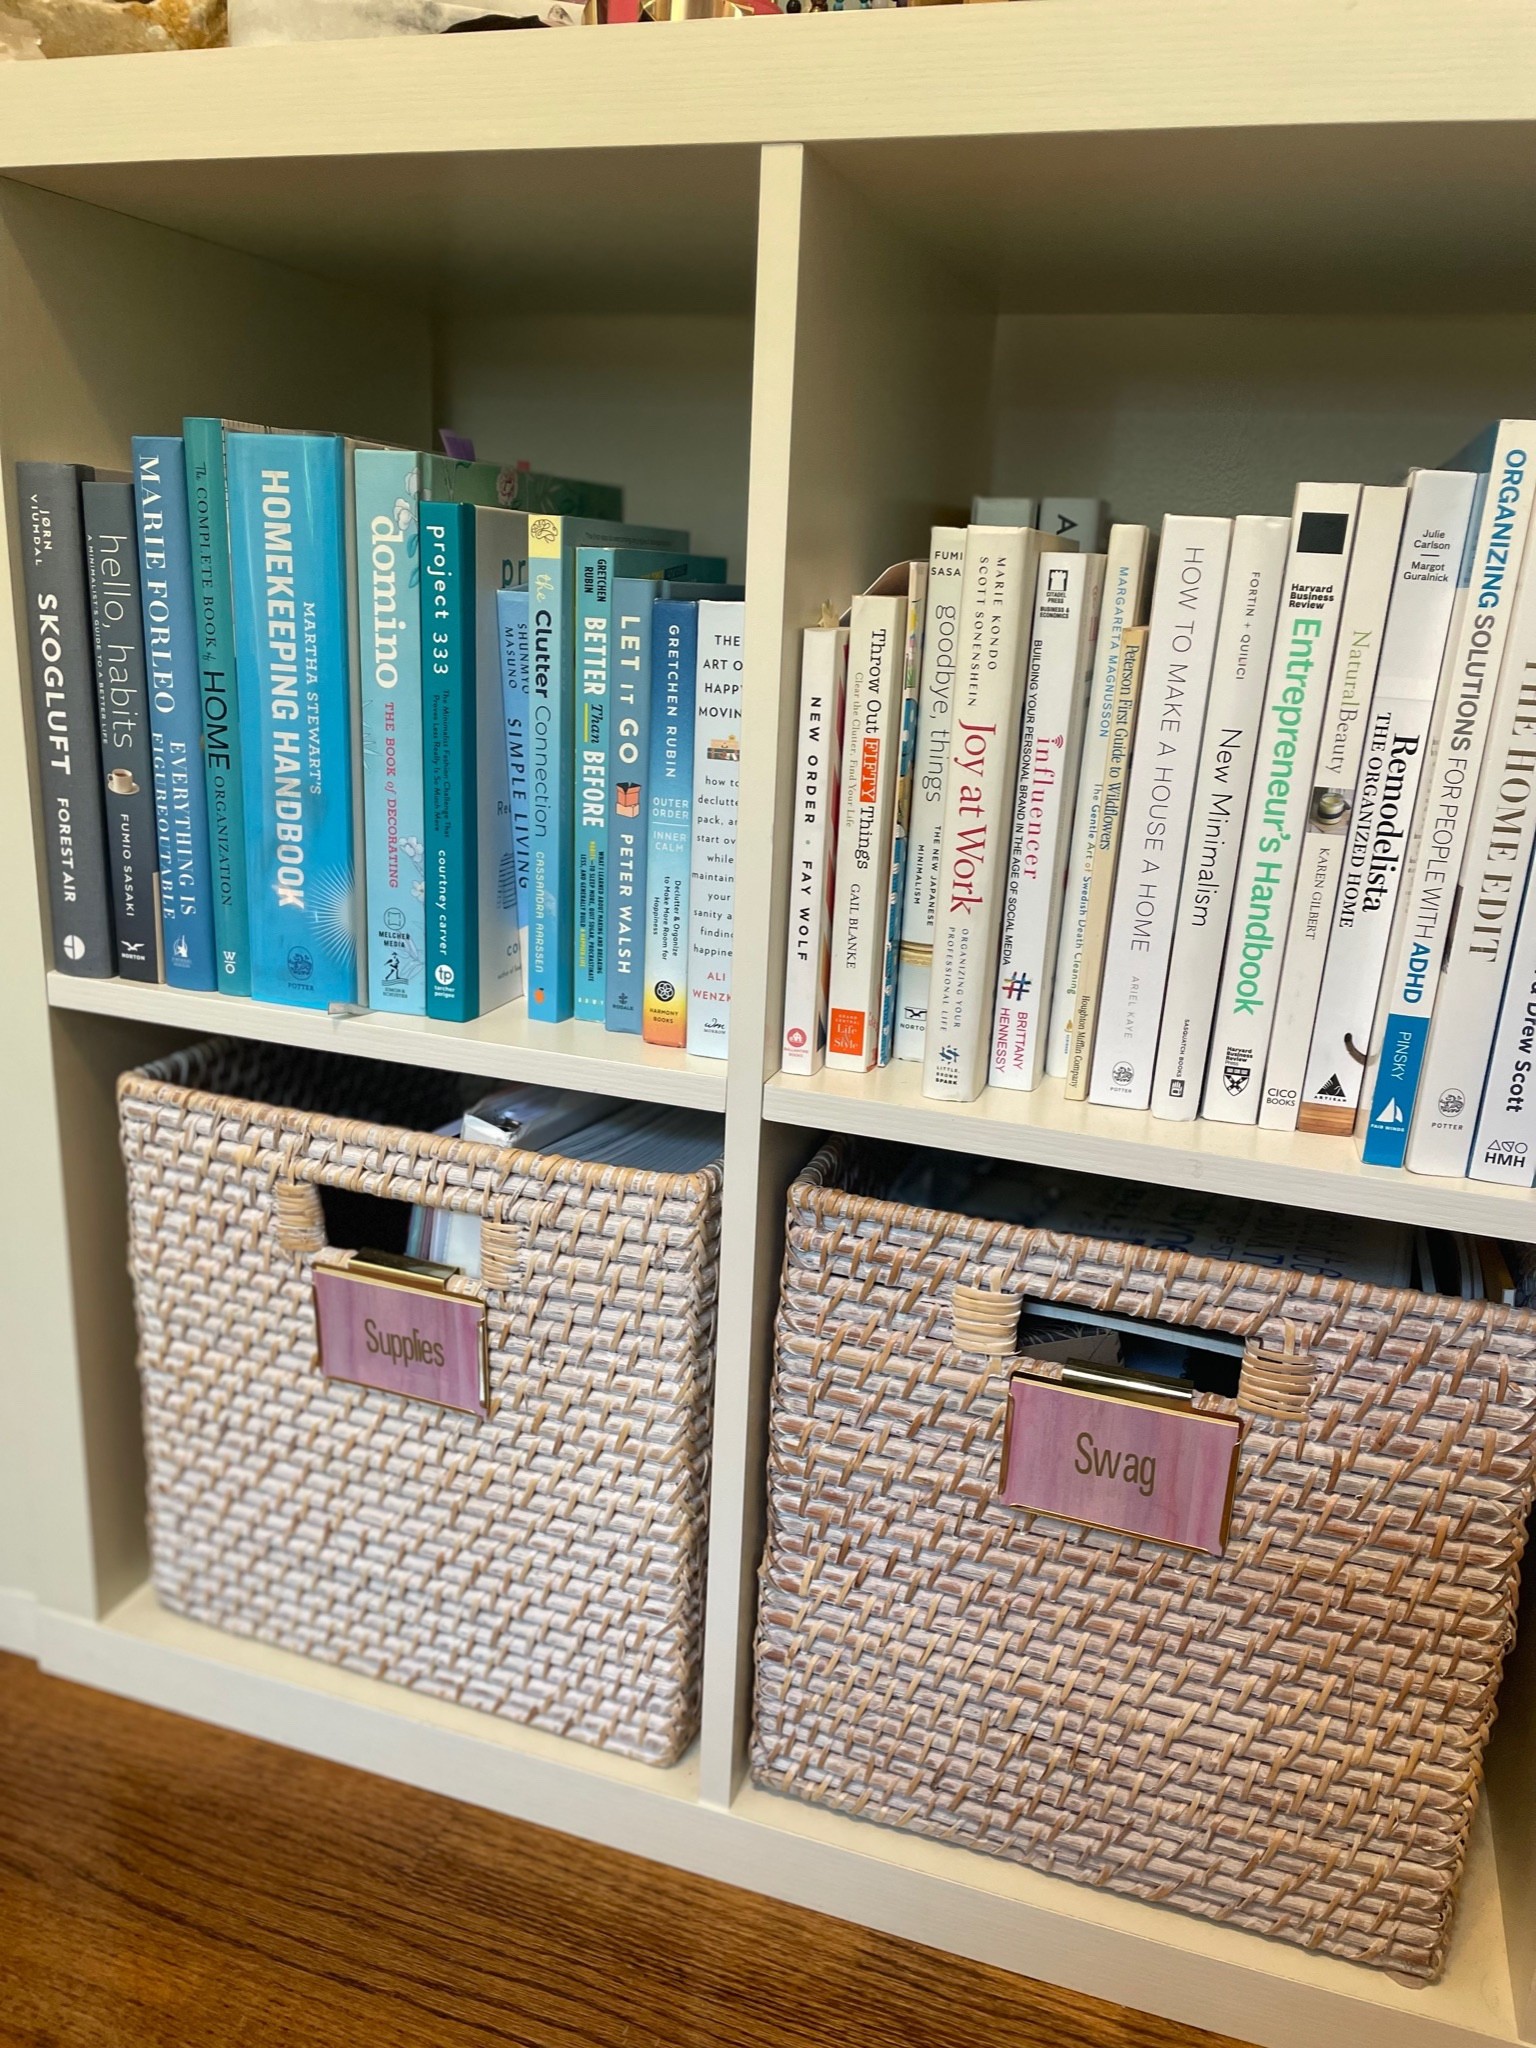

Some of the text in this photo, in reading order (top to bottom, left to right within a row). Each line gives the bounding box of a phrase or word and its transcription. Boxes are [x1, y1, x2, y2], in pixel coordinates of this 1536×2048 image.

[39, 509, 53, 550] JØRN
[1413, 540, 1450, 550] Carlson
[1423, 529, 1446, 539] Julie
[139, 454, 175, 713] MARIE FORLEO
[426, 525, 453, 674] project 333
[584, 566, 594, 593] RUBIN
[597, 559, 607, 602] GRETCHEN
[1246, 571, 1261, 617] FORTIN
[1290, 592, 1335, 601] Business
[1291, 583, 1333, 593] Harvard
[1403, 571, 1448, 583] Guralnick
[1411, 561, 1445, 572] Margot
[370, 515, 407, 689] domino
[968, 557, 989, 706] SCOTT SONENSHEIN
[987, 557, 1007, 670] MARIE KONDO
[1288, 600, 1325, 609] Review
[99, 534, 138, 748] hello, habits
[505, 627, 517, 688] MASUNO
[703, 660, 728, 670] ART
[714, 635, 741, 647] THE
[1099, 566, 1129, 737] MARGARETA MAGNUSSON
[38, 593, 71, 775] SKOGLUFT
[196, 487, 232, 906] COMPLETE BOOK HOME ORGANIZATION
[261, 470, 305, 909] HOMEKEEPING HANDBOOK
[303, 601, 321, 795] MARTHA STEWART'S
[535, 574, 554, 837] the Clutter Connection
[619, 615, 641, 764] LET IT GO
[666, 625, 680, 778] GRETCHEN RUBIN
[853, 672, 864, 699] Clear
[922, 605, 957, 802] goodbye, things
[583, 617, 607, 828] BETTER Than BEFORE
[854, 628, 886, 869] Throw Out FIFTY Things
[1100, 645, 1139, 854] Peterson First Guide to Wildflowers
[1131, 547, 1205, 953] HOW TO MAKE A HOUSE A HOME
[1403, 449, 1527, 1004] ORGANIZING SOLUTIONS FOR PEOPLE WITH ADHD
[384, 702, 398, 888] THE BOOK DECORATING
[507, 718, 530, 888] SIMPLE LIVING
[652, 808, 689, 819] ORDER
[653, 797, 689, 808] OUTER
[705, 776, 725, 786] how
[1002, 639, 1043, 966] BUILDING YOUR PERSONAL BRAND IN THE AGE OF SOCIAL MEDIA
[57, 798, 76, 902] FOREST AIR
[152, 733, 175, 919] FIGUREOUTABLE
[170, 741, 196, 915] EVERYTHING IS
[653, 831, 687, 841] INNER
[655, 842, 684, 852] CALM
[696, 834, 720, 844] start
[697, 815, 724, 826] pack,
[798, 697, 822, 961] NEW ORDER FAY WOLF
[950, 719, 997, 915] Joy at Work
[1191, 728, 1244, 927] New Minimalism
[1339, 712, 1392, 928] THE ORGANIZED HOME
[1361, 733, 1421, 913] Remodelista
[120, 814, 134, 916] FUMIO SASAKI
[691, 872, 734, 884] maintain
[707, 854, 734, 864] while
[913, 844, 925, 905] MINIMALISM
[926, 826, 941, 926] THE NEW JAPANESE
[1079, 805, 1100, 916] Gentle Swedish
[1469, 747, 1536, 962] HOME EDIT
[435, 850, 448, 956] courtney carver
[618, 834, 634, 974] PETER WALSH
[693, 909, 723, 921] sanity
[707, 893, 731, 903] your
[846, 883, 861, 970] GAIL BLANKE
[1305, 848, 1331, 940] KAREN GILBERT
[1233, 861, 1283, 1016] Handbook
[706, 972, 726, 982] ALI
[1124, 976, 1140, 1039] ARIEL KAYE
[649, 1008, 679, 1016] HARMONY
[953, 1000, 963, 1028] YOUR
[995, 1007, 1011, 1073] HENNESSY
[1013, 1011, 1028, 1070] BRITTANY
[1391, 1031, 1412, 1081] PINSKY
[1506, 1061, 1532, 1112] Scott
[1266, 1097, 1296, 1107] BOOKS
[1267, 1087, 1297, 1099] CICO
[1431, 1122, 1463, 1131] POTTER
[1484, 1152, 1526, 1168] HMH
[364, 1318, 445, 1368] Supplies
[1074, 1432, 1156, 1497] Swag
